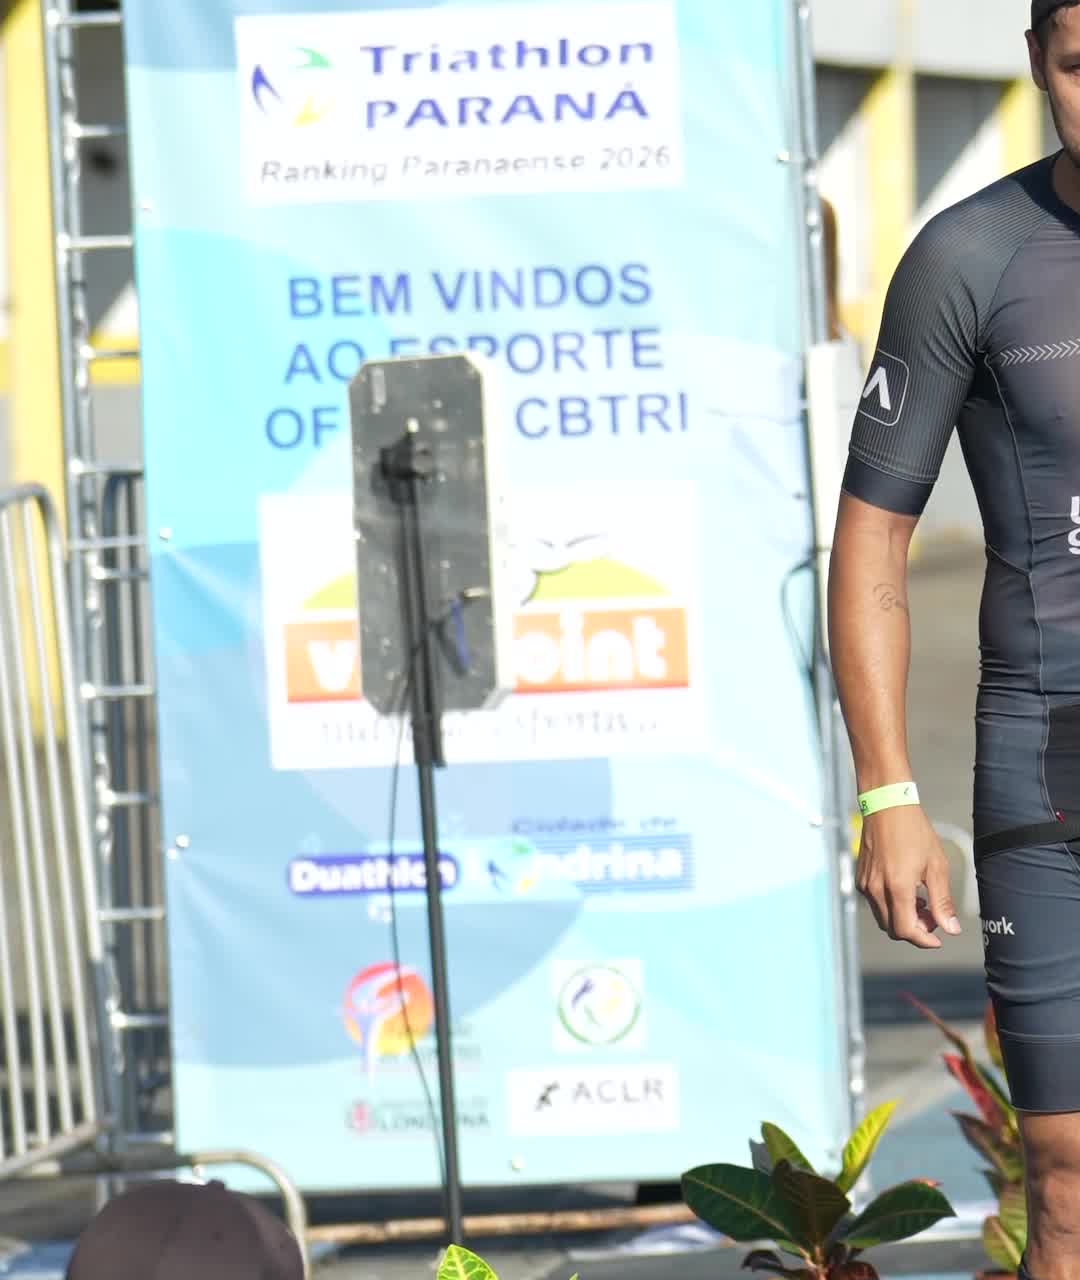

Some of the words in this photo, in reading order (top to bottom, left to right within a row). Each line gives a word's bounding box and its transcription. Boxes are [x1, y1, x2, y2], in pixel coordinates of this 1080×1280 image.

[360, 38, 654, 75] Triathlon
[365, 81, 651, 130] PARANÁ
[260, 159, 388, 186] Ranking
[401, 151, 585, 179] Paranaense
[600, 145, 670, 170] 2026
[287, 272, 412, 320] BEM
[432, 262, 653, 312] VINDOS
[283, 339, 366, 385] AO
[514, 392, 688, 440] CBTRI
